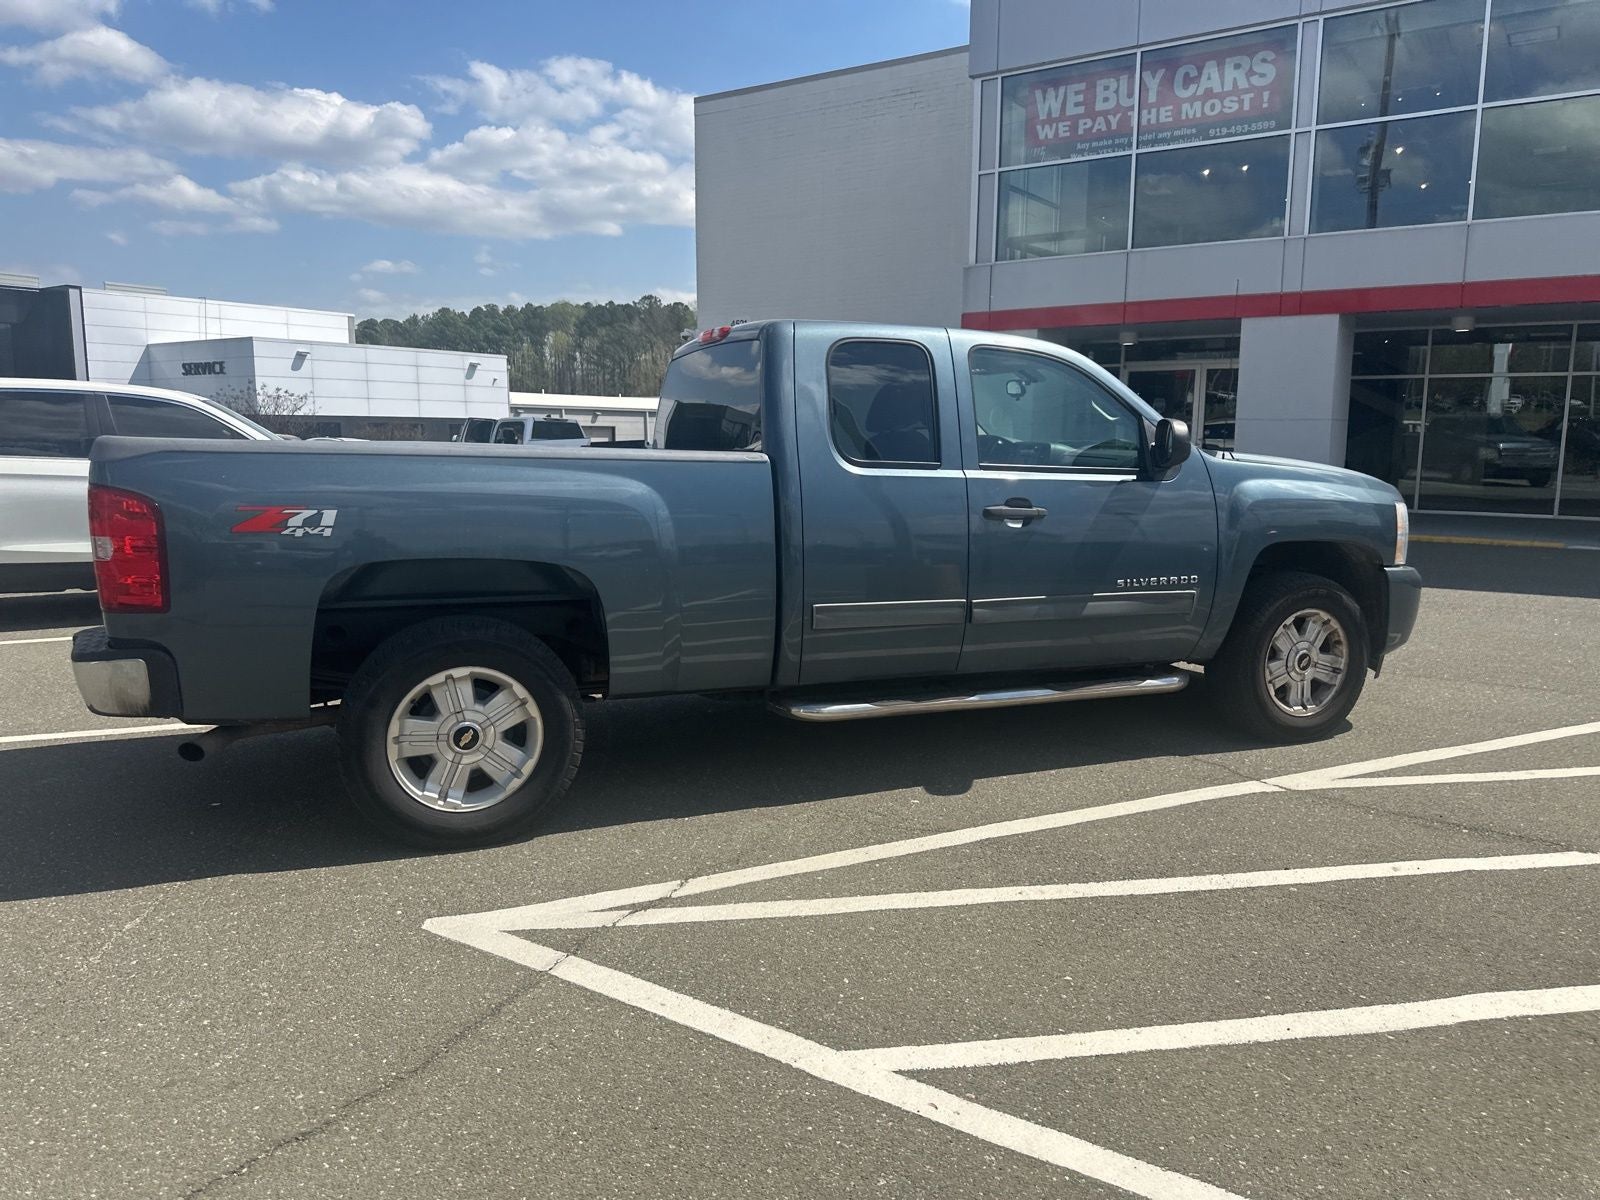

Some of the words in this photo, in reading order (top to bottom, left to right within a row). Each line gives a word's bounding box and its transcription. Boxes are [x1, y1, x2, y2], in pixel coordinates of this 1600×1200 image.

[1034, 82, 1086, 119] WE
[1095, 69, 1165, 111] BUY
[1174, 50, 1276, 98] CARS
[1036, 121, 1071, 139] WE
[1077, 113, 1122, 135] PAY
[1128, 105, 1173, 127] THE
[1181, 92, 1254, 120] MOST
[1076, 142, 1090, 151] Any
[1091, 138, 1112, 147] make
[1114, 136, 1129, 145] any
[1157, 131, 1171, 140] any
[1173, 127, 1197, 137] miles
[1208, 120, 1276, 137] 919-493-5599
[181, 361, 226, 376] SERVICE
[231, 505, 338, 533] Z71
[1117, 575, 1198, 588] SILVERADO
